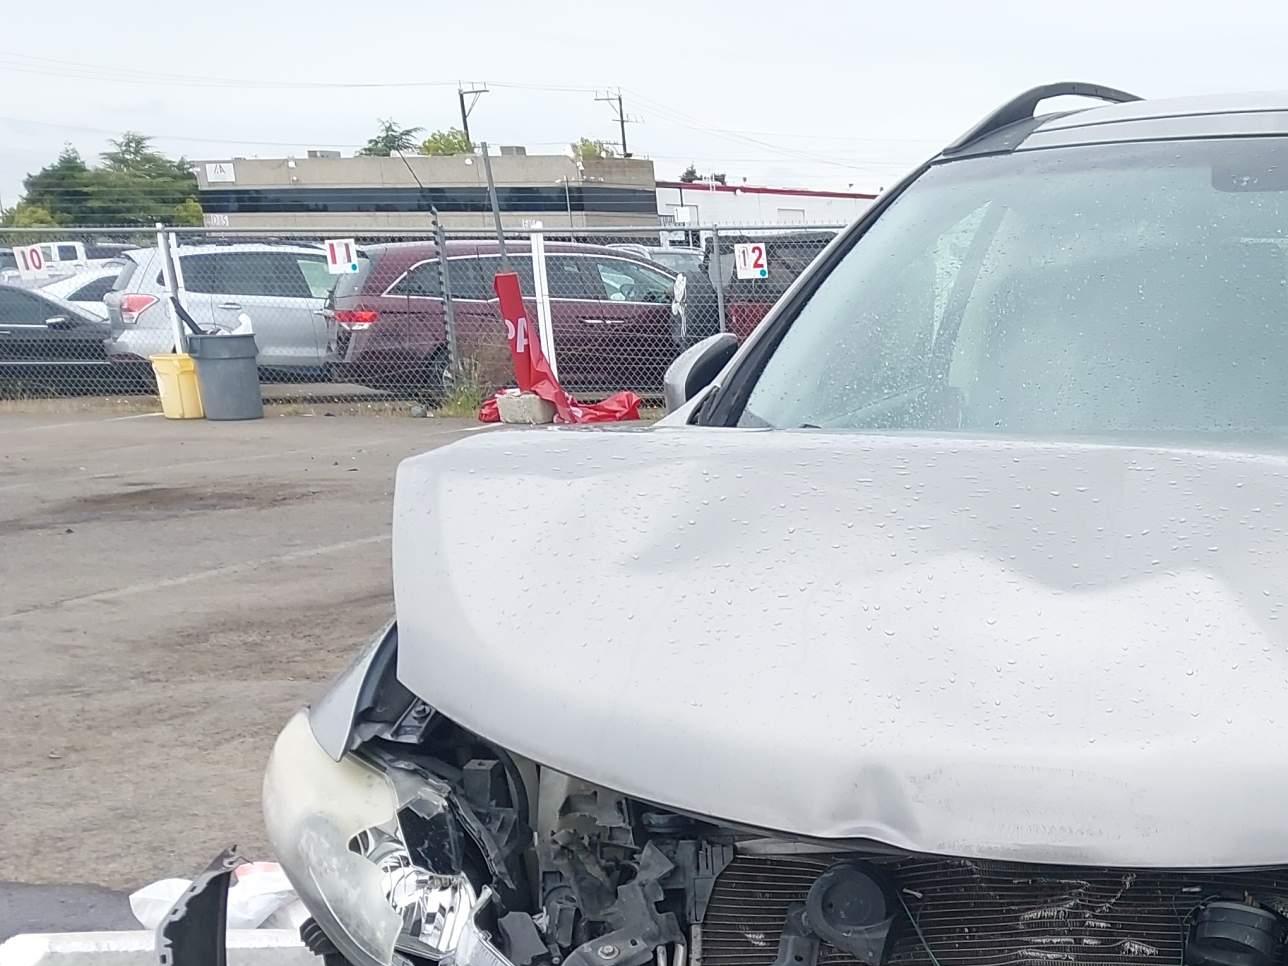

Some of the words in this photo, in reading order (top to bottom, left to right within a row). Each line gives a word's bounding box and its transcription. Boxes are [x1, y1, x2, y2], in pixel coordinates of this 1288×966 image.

[20, 248, 42, 271] 10
[328, 242, 352, 265] 11
[741, 245, 764, 269] 12
